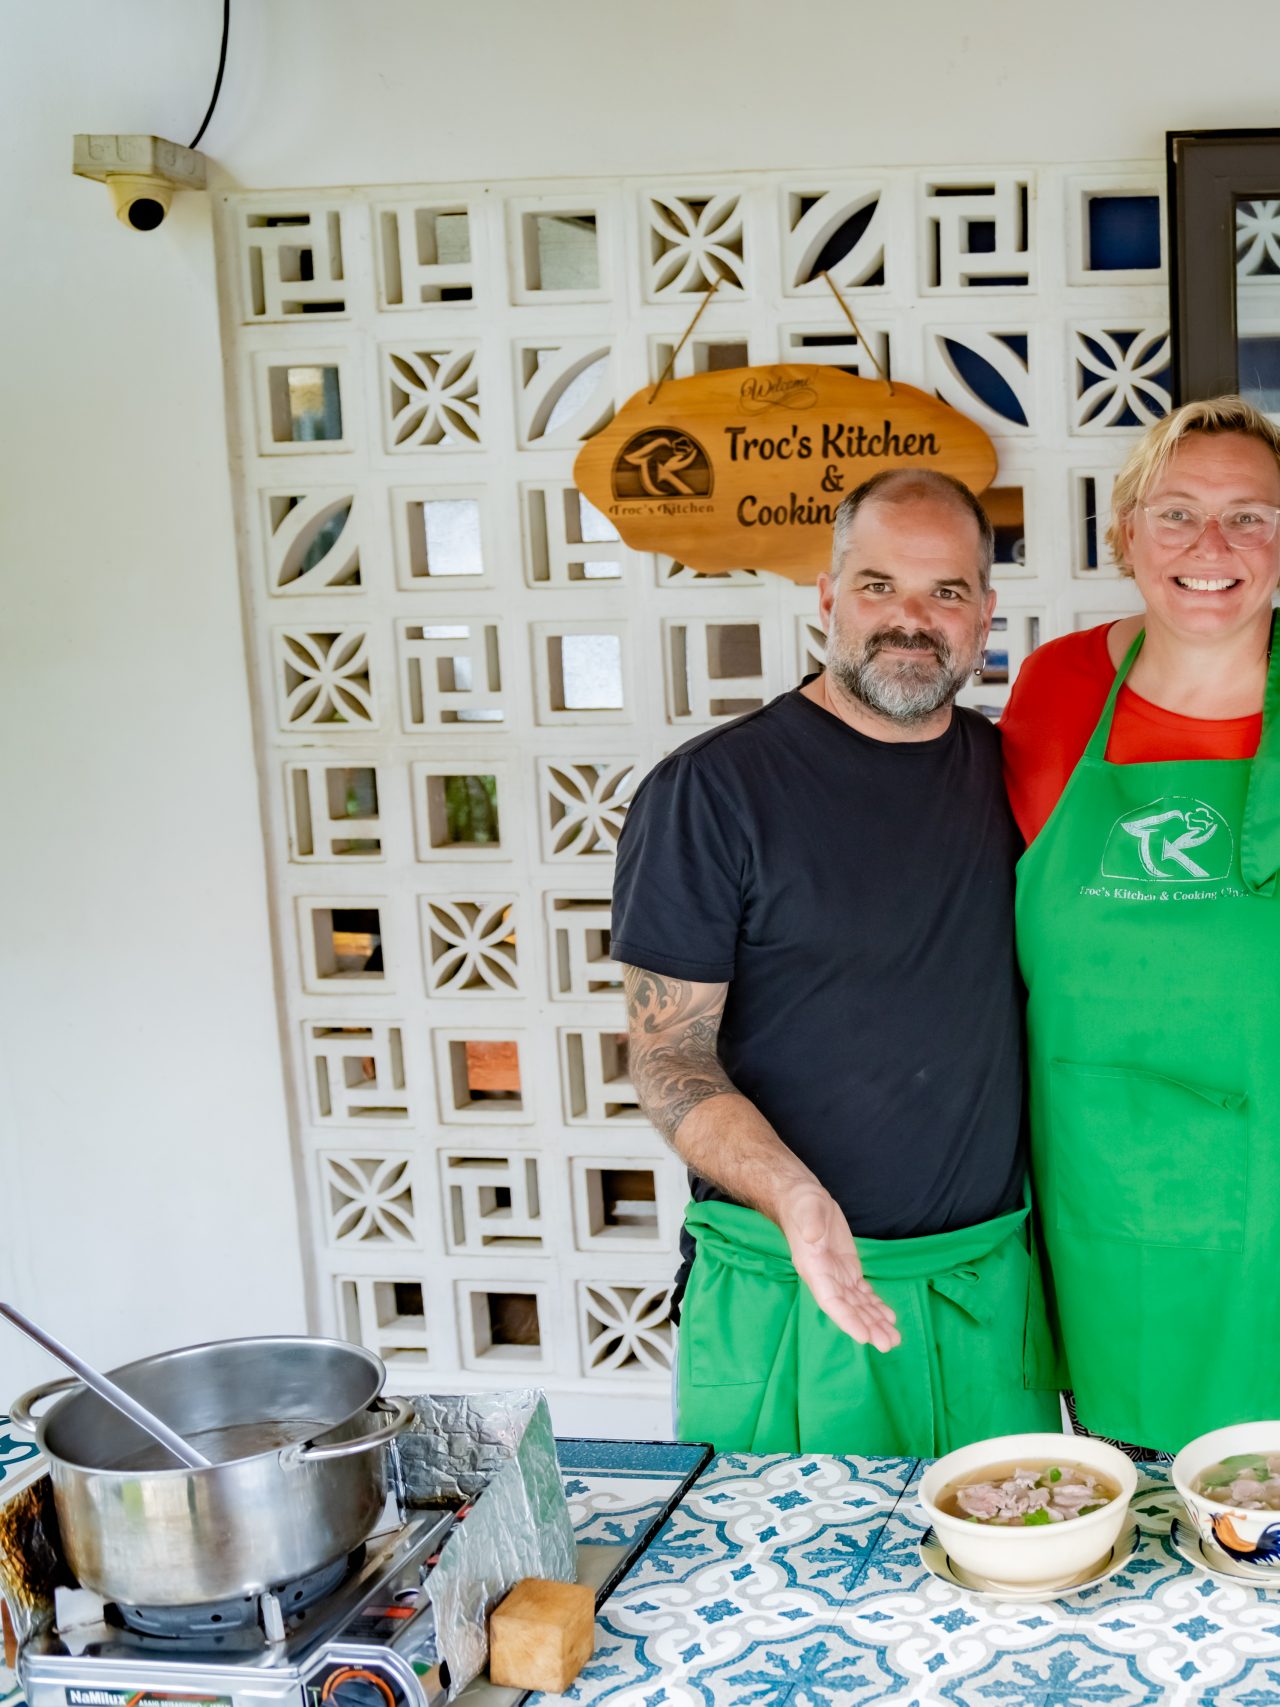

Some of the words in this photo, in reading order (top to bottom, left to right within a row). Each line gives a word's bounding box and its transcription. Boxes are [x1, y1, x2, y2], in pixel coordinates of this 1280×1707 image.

[724, 425, 813, 462] Troc's
[821, 420, 941, 459] Kitchen
[820, 464, 844, 493] &
[608, 503, 654, 516] Troc's
[657, 502, 714, 516] Kitchen
[736, 492, 839, 528] Cookin
[1113, 888, 1156, 901] Kitchen
[1160, 891, 1169, 901] &
[1172, 890, 1218, 901] Cooking
[69, 1689, 127, 1706] NaMilux
